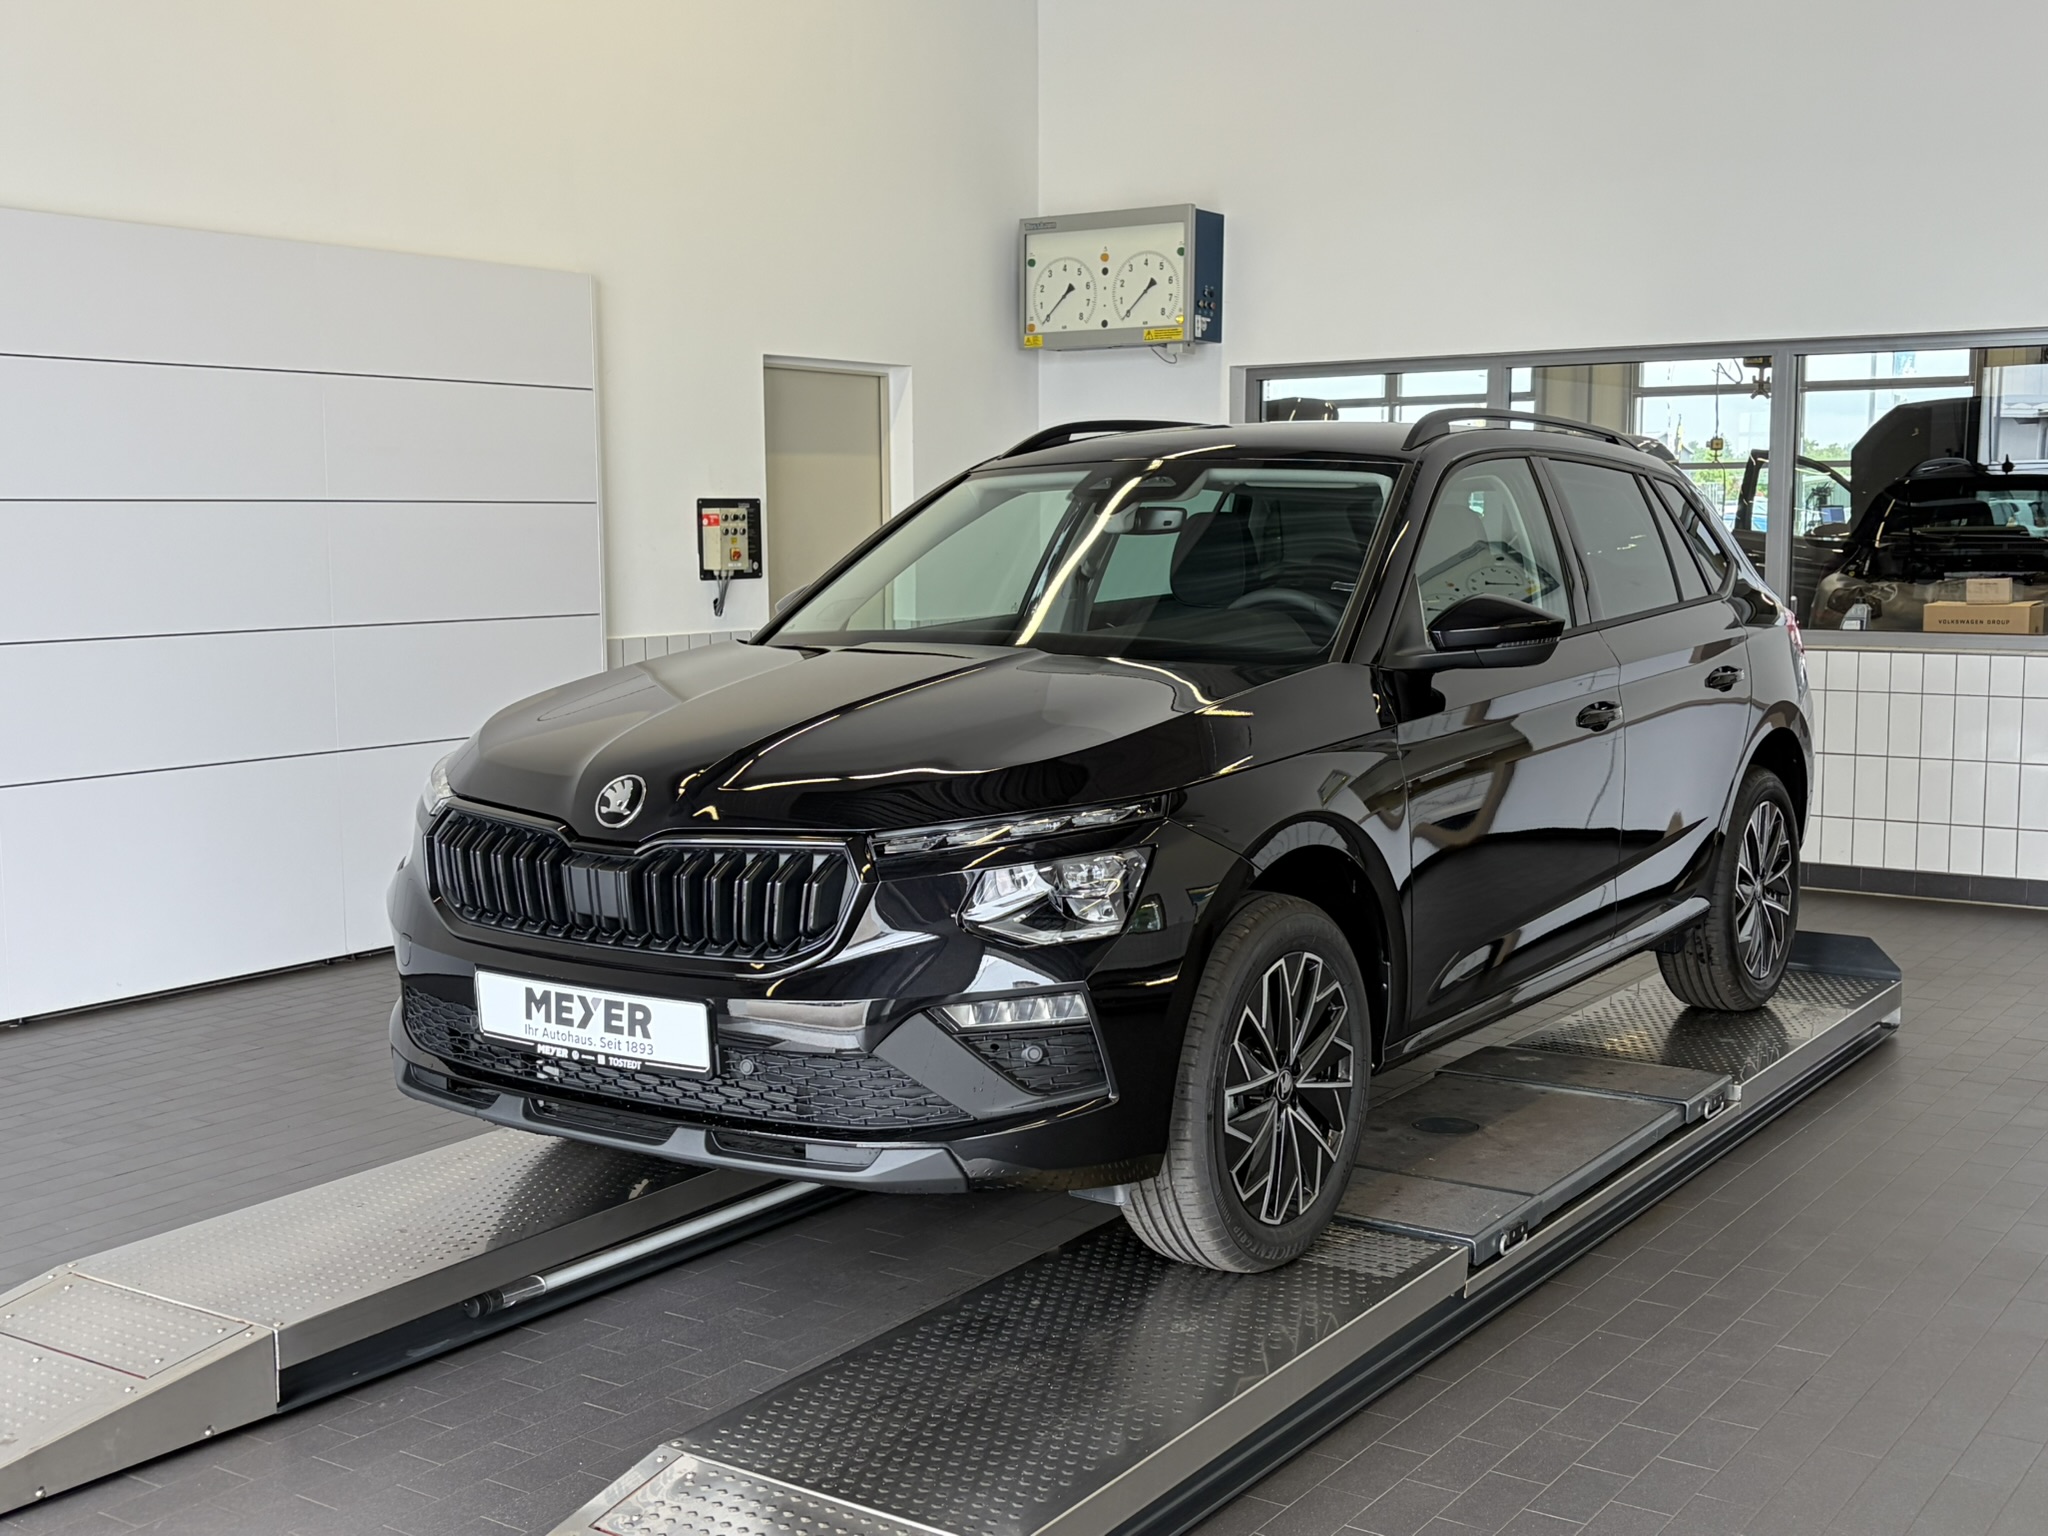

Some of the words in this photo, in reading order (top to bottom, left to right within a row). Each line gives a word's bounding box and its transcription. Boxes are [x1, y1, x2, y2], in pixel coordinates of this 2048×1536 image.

[1144, 258, 1149, 266] 4
[1159, 262, 1164, 270] 5
[1062, 264, 1067, 272] 4
[1077, 267, 1082, 276] 5
[1128, 264, 1133, 272] 3
[1048, 269, 1053, 278] 3
[1120, 279, 1125, 288] 2
[1168, 276, 1173, 284] 6
[1040, 284, 1045, 293] 2
[1085, 281, 1091, 290] 6
[1168, 293, 1173, 301] 7
[1086, 298, 1091, 306] 7
[1126, 309, 1131, 318] 0
[1160, 307, 1166, 316] 8
[1045, 314, 1051, 323] 0
[1078, 312, 1084, 321] 8
[525, 986, 652, 1039] MEYER
[525, 1024, 538, 1037] Ihr
[542, 1027, 596, 1047] Autohaus.
[600, 1036, 622, 1051] Seit
[625, 1040, 654, 1055] 1893
[537, 1043, 568, 1058] MEYER
[608, 1056, 642, 1070] TOSTEDT
